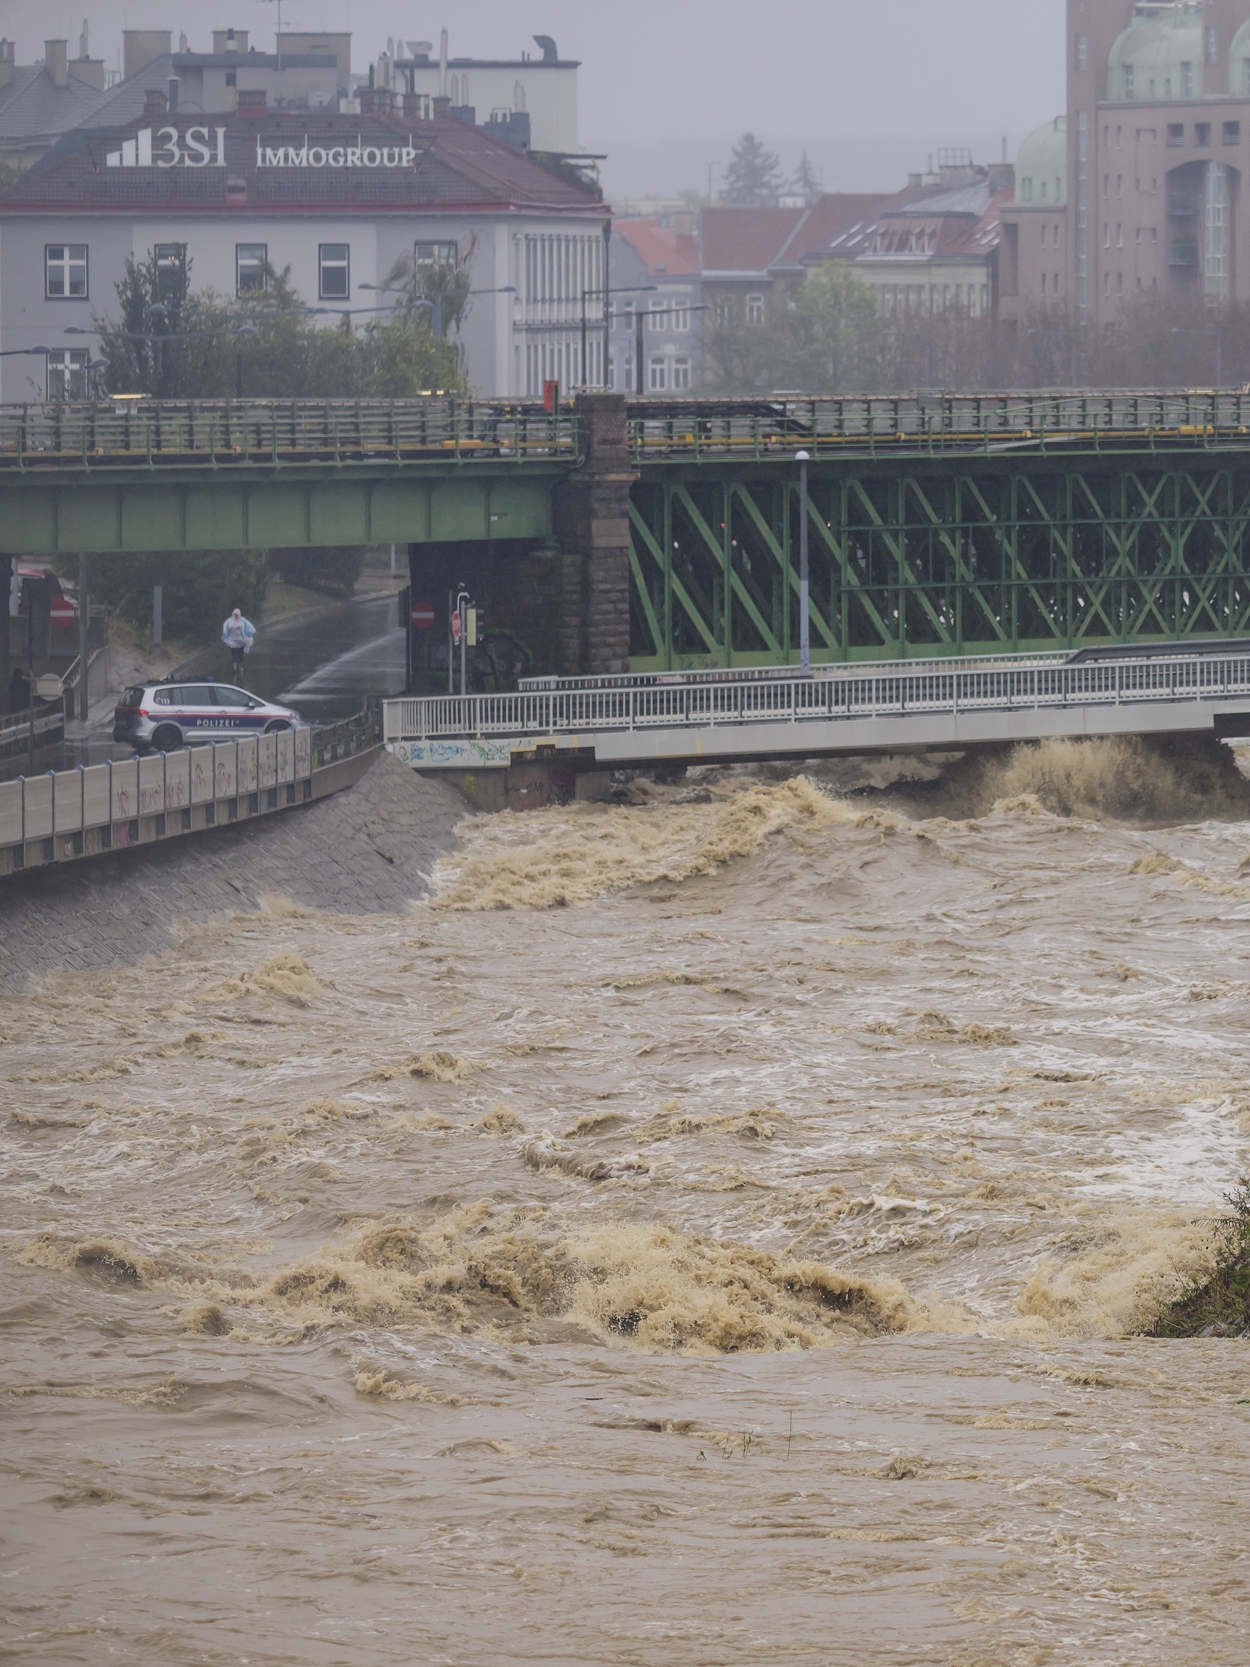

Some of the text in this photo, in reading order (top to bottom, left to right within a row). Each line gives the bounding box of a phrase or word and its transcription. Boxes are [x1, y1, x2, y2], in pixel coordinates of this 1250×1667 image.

[157, 127, 416, 168] 3SI IMMOGROUP
[196, 719, 234, 727] POLIZEI
